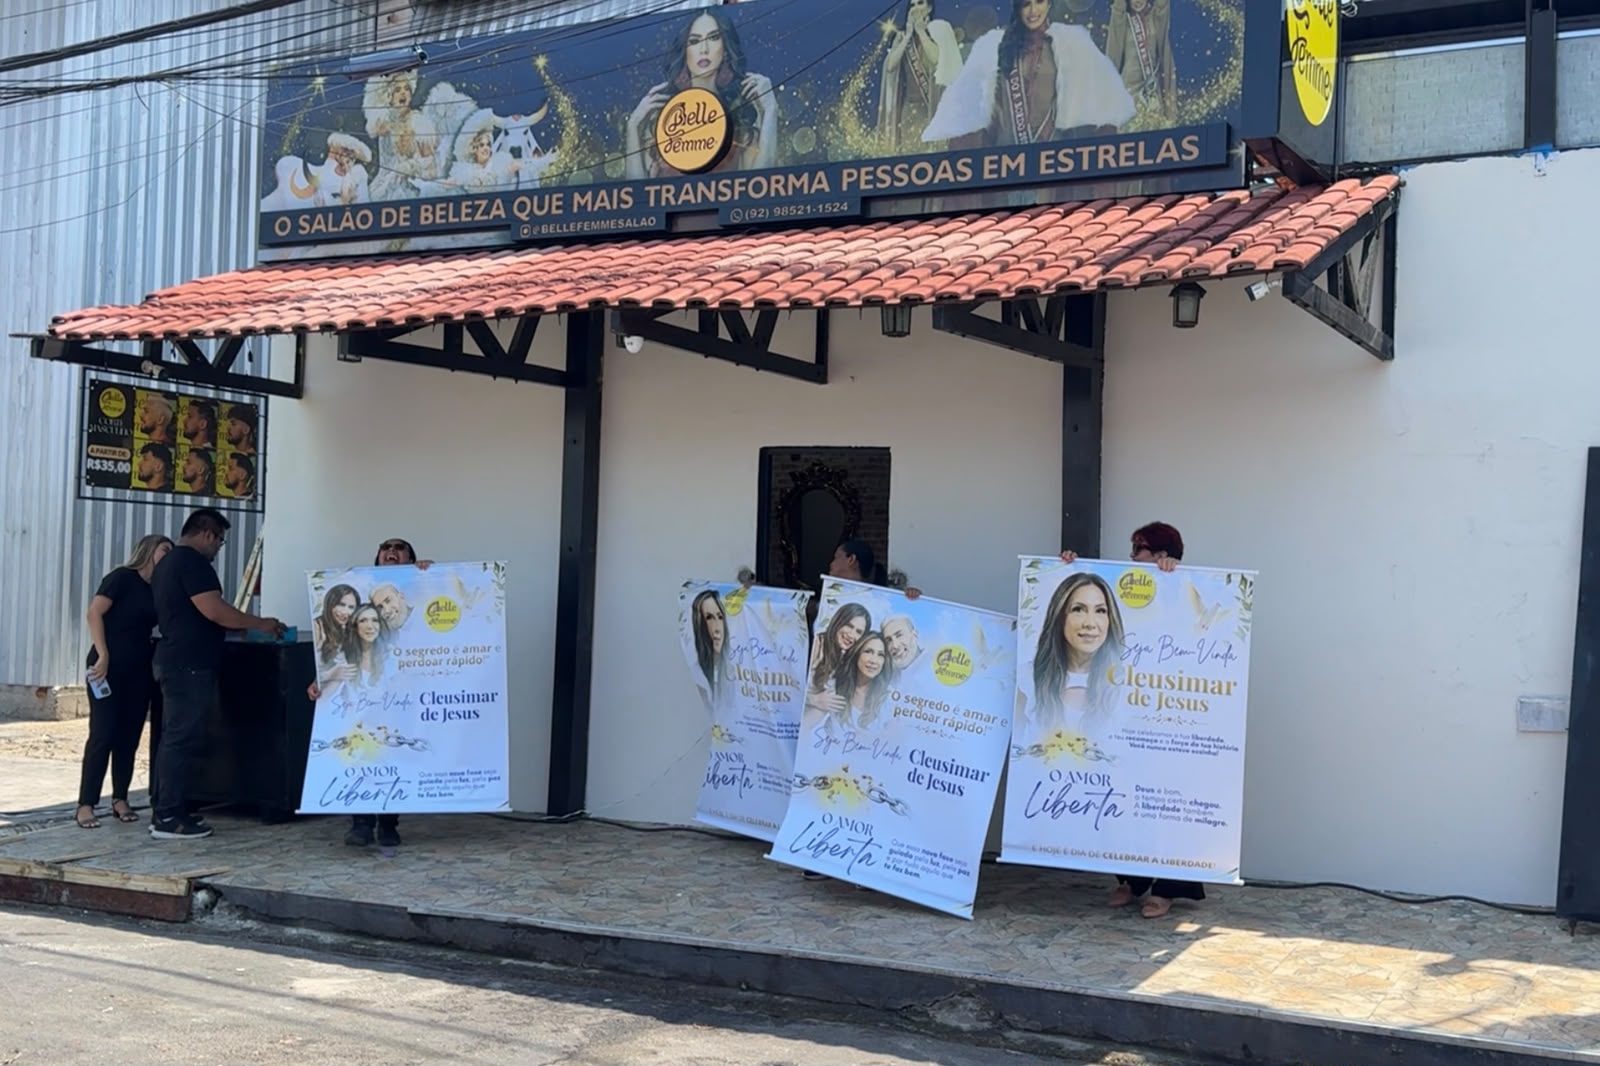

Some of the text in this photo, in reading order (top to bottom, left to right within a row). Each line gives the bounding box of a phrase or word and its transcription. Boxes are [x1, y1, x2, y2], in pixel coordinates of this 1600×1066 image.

[662, 101, 718, 137] Belle
[274, 216, 292, 237] O
[298, 207, 373, 236] SALÃO
[381, 205, 411, 228] DE
[419, 198, 507, 225] BELEZA
[512, 192, 564, 222] QUE
[572, 186, 634, 214] MAIS
[644, 170, 831, 208] TRANSFORMA
[841, 157, 974, 192] PESSOAS
[982, 152, 1026, 180] EM
[1039, 135, 1201, 175] ESTRELAS
[745, 201, 849, 220] (92) 98521-1524
[87, 458, 131, 474] R$35,00
[405, 645, 450, 658] segredo
[462, 645, 492, 654] amar
[1158, 634, 1196, 664] Bem
[1197, 638, 1238, 668] Vinda
[398, 657, 442, 671] perdoar
[1107, 664, 1238, 696] Cleusimar
[419, 690, 499, 706] Cleusimar
[903, 693, 950, 714] segredo
[963, 708, 999, 725] amar
[1000, 719, 1009, 728] e
[1127, 687, 1209, 712] de Jesus
[420, 707, 480, 724] de Jesus
[893, 705, 940, 724] perdoar
[344, 766, 399, 778] O AMOR
[909, 748, 991, 783] Cleusimar
[907, 767, 965, 797] de Jesus
[1049, 769, 1112, 788] O AMOR
[319, 776, 412, 811] Liberta
[1024, 780, 1127, 832] Liberta
[1141, 801, 1181, 812] liberdade
[821, 812, 875, 837] O AMOR
[789, 821, 883, 877] Liberta
[1102, 851, 1150, 864] CELEBRAR
[1152, 856, 1159, 864] A
